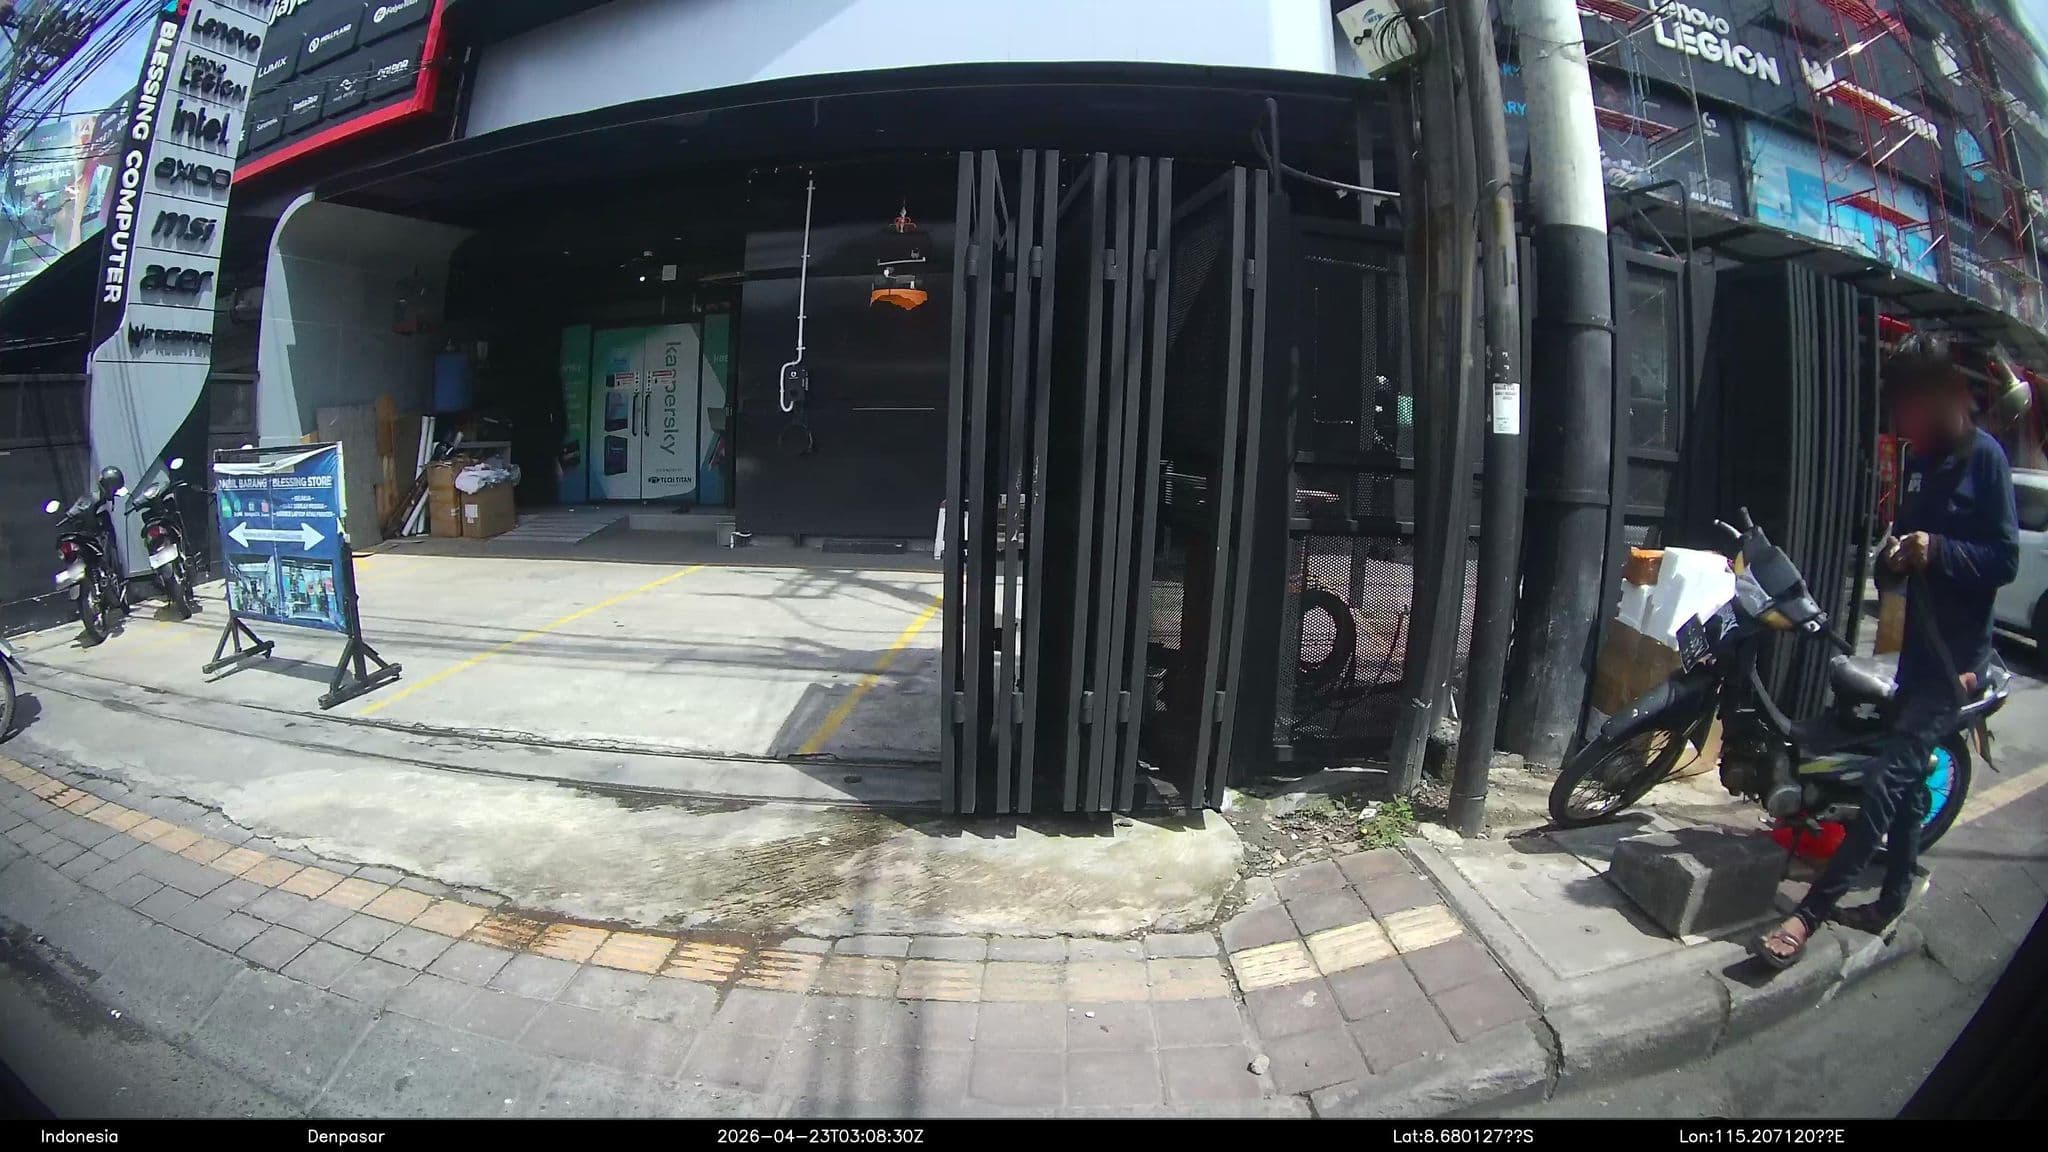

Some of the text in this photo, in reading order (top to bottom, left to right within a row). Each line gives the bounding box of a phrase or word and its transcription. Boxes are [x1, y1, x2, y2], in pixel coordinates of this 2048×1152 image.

[191, 9, 261, 53] Lenovo
[1649, 0, 1730, 34] Lenovo
[185, 49, 227, 74] Lenovo
[1652, 14, 1781, 85] LEGION
[132, 20, 178, 142] BLESSING
[179, 67, 248, 98] LEGION
[257, 56, 287, 79] LUMIX
[171, 99, 231, 146] intel
[103, 149, 143, 304] COMPUTER
[151, 210, 217, 242] msi
[140, 264, 214, 297] acer
[272, 476, 307, 488] BLESSING
[307, 475, 333, 486] STORE
